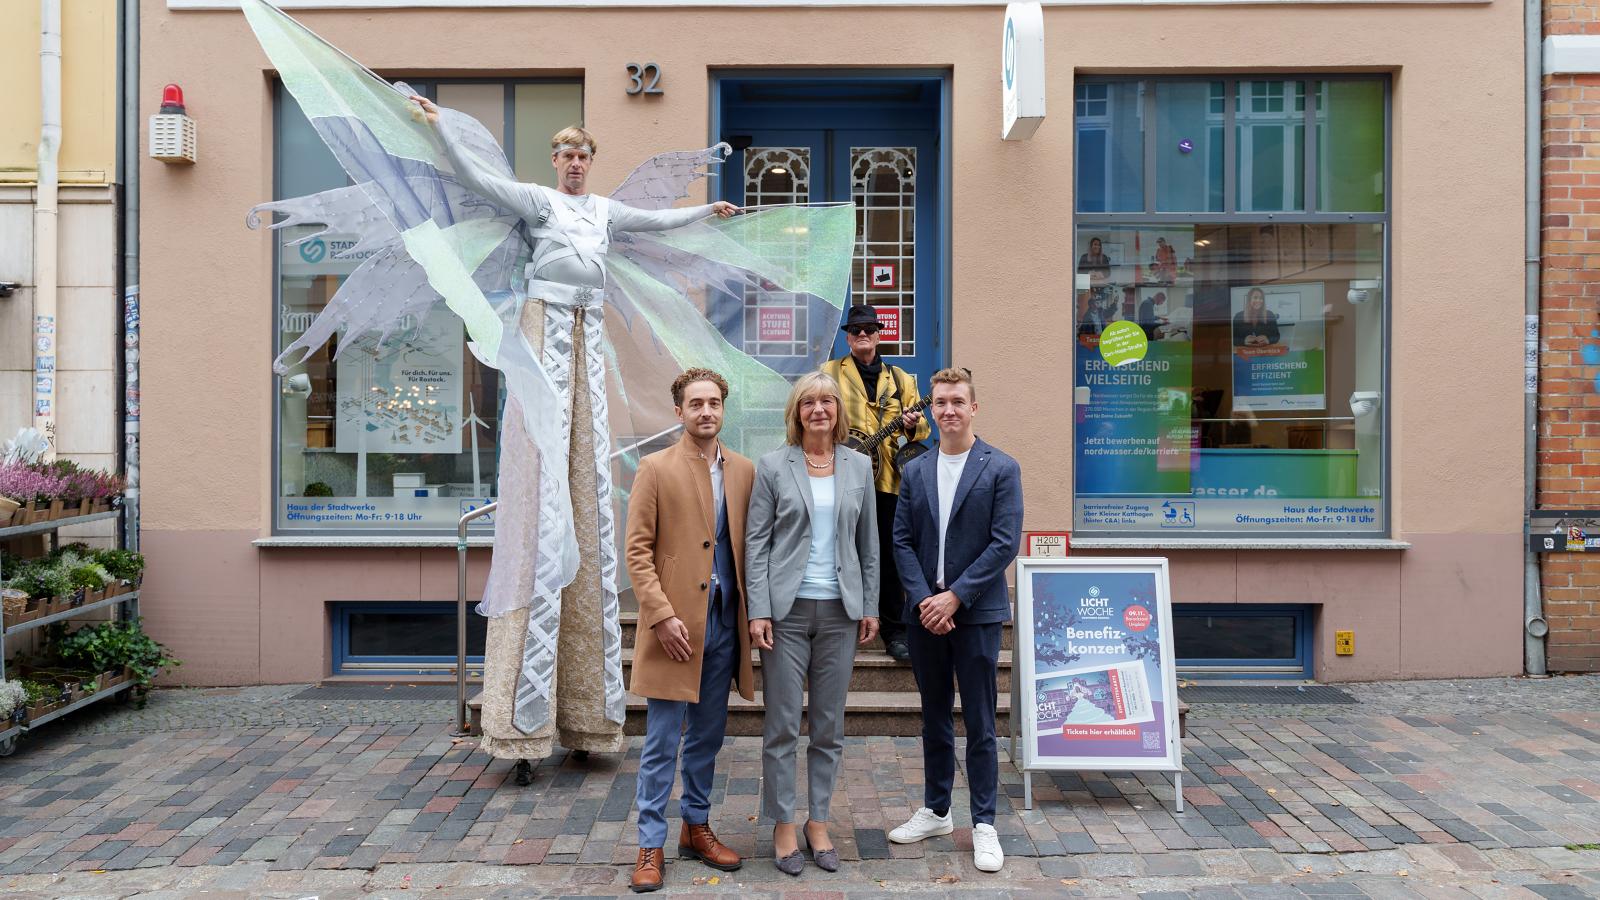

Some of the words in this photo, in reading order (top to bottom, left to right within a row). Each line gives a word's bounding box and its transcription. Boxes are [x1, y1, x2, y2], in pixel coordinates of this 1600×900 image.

[625, 62, 664, 96] 32
[762, 320, 790, 329] STUFE!
[1251, 361, 1308, 371] ERFRISCHEND
[1085, 374, 1152, 385] VIELSEITIG
[1251, 371, 1292, 380] EFFIZIENT
[1084, 437, 1104, 446] Jetzt
[1105, 437, 1146, 445] bewerben
[1147, 437, 1160, 445] auf
[1084, 447, 1179, 456] nordwasser.de/karriere
[287, 503, 309, 511] Haus
[311, 503, 325, 511] der
[327, 503, 376, 511] Stadtwerke
[1283, 505, 1306, 514] Haus
[1308, 505, 1322, 514] der
[1325, 505, 1375, 514] Stadtwerke
[287, 511, 353, 522] Öffnungszeiten:
[355, 513, 382, 521] Mo-Fr:
[384, 513, 405, 521] 9-18
[407, 513, 423, 521] Uhr
[1083, 517, 1103, 525] (hinter
[1104, 517, 1121, 525] C&A)
[1235, 514, 1303, 525] Öffnungszeiten:
[1305, 515, 1334, 523] Mo-Fr:
[1335, 515, 1356, 523] 9-18
[1358, 515, 1375, 523] Uhr
[1080, 598, 1109, 607] LICHT
[1077, 607, 1114, 616] WOCHE
[1066, 627, 1127, 639] Benefiz-
[1068, 641, 1127, 655] konzert
[1036, 701, 1057, 712] CHT
[1036, 709, 1061, 720] OCHE
